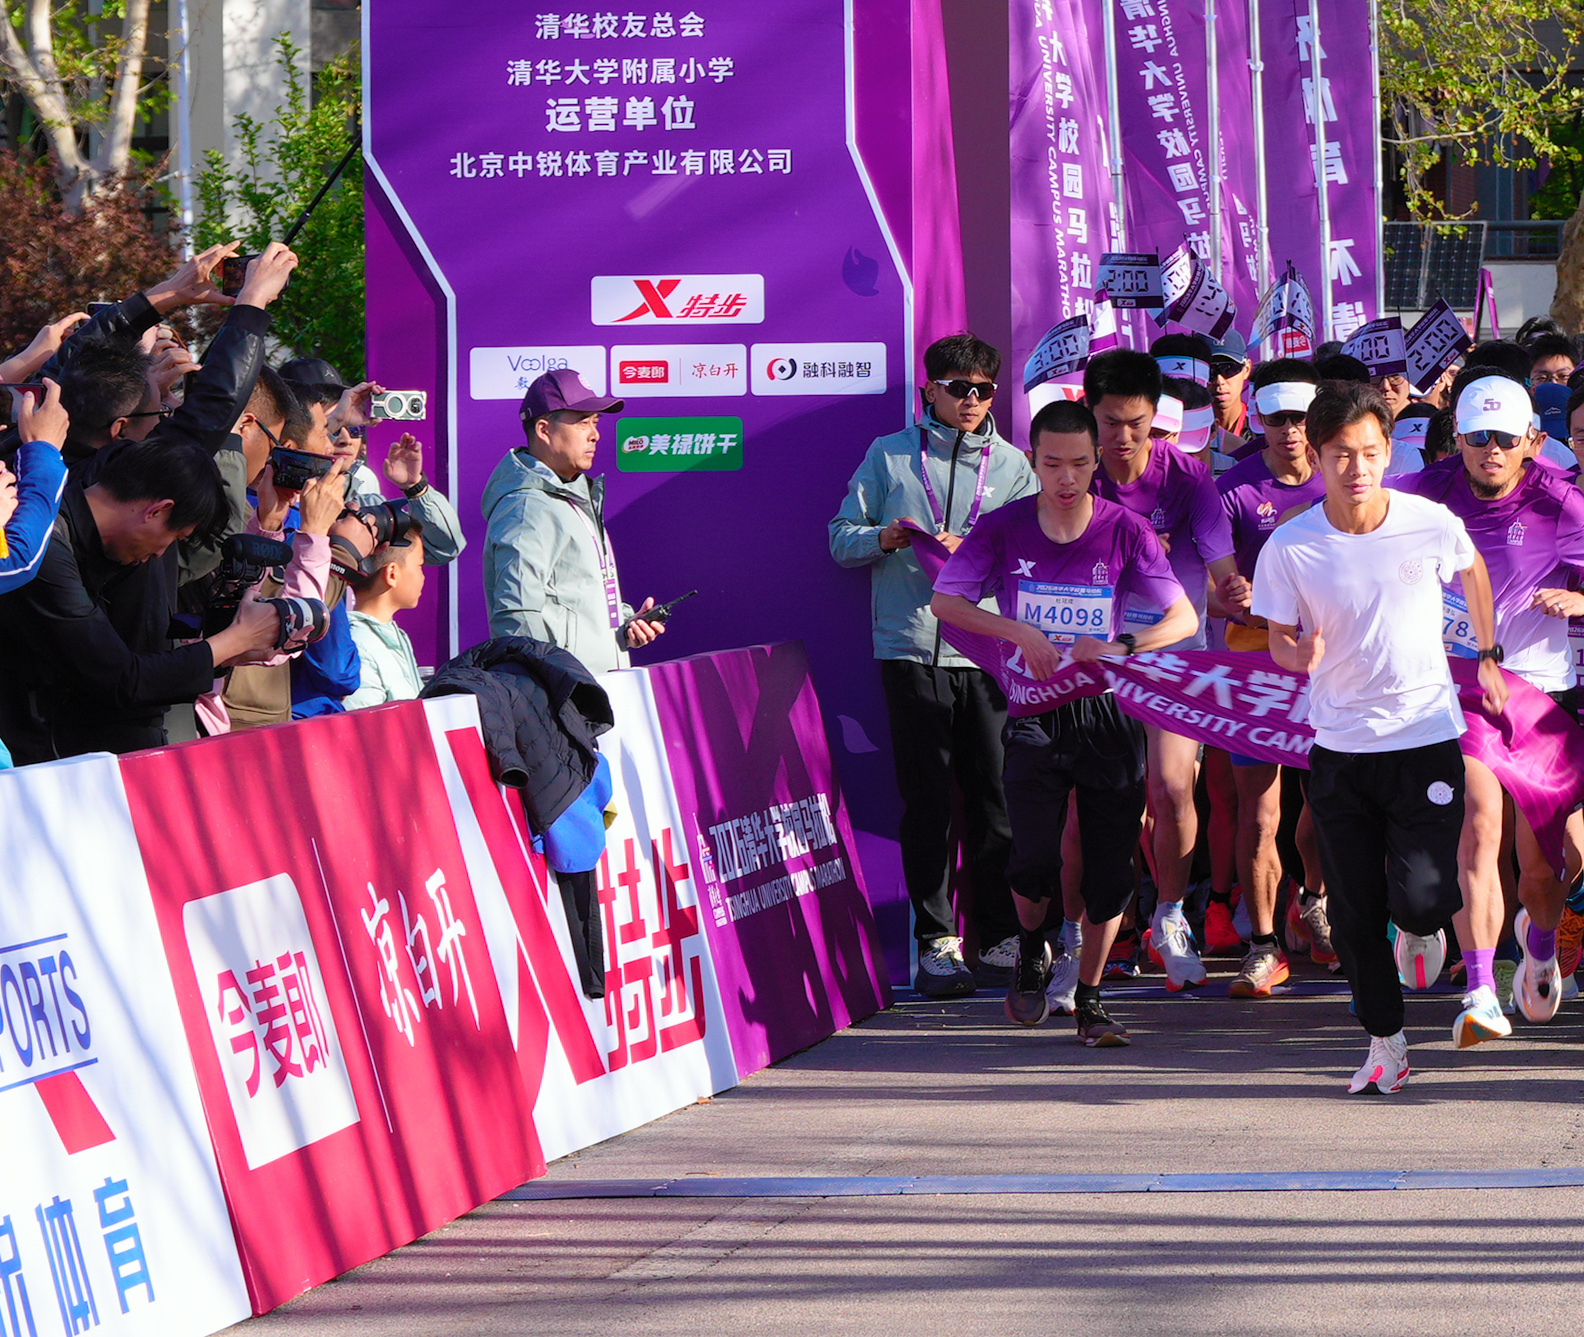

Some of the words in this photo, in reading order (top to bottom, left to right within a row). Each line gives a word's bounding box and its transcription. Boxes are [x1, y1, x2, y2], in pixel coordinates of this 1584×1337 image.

[535, 11, 705, 40] 清华校友总会
[506, 57, 734, 86] 清华大学附属小学
[545, 95, 696, 133] 运营单位
[449, 148, 792, 178] 北京中锐体育产业有限公司
[1054, 226, 1071, 320] MARATHO
[676, 293, 748, 319] 特步
[622, 367, 666, 380] 今麦郎
[691, 363, 739, 380] 凉白开
[803, 361, 872, 379] 融科融智
[649, 434, 738, 456] 美禄饼干
[1024, 603, 1104, 626] M4098
[216, 951, 329, 1100] 今麦郎
